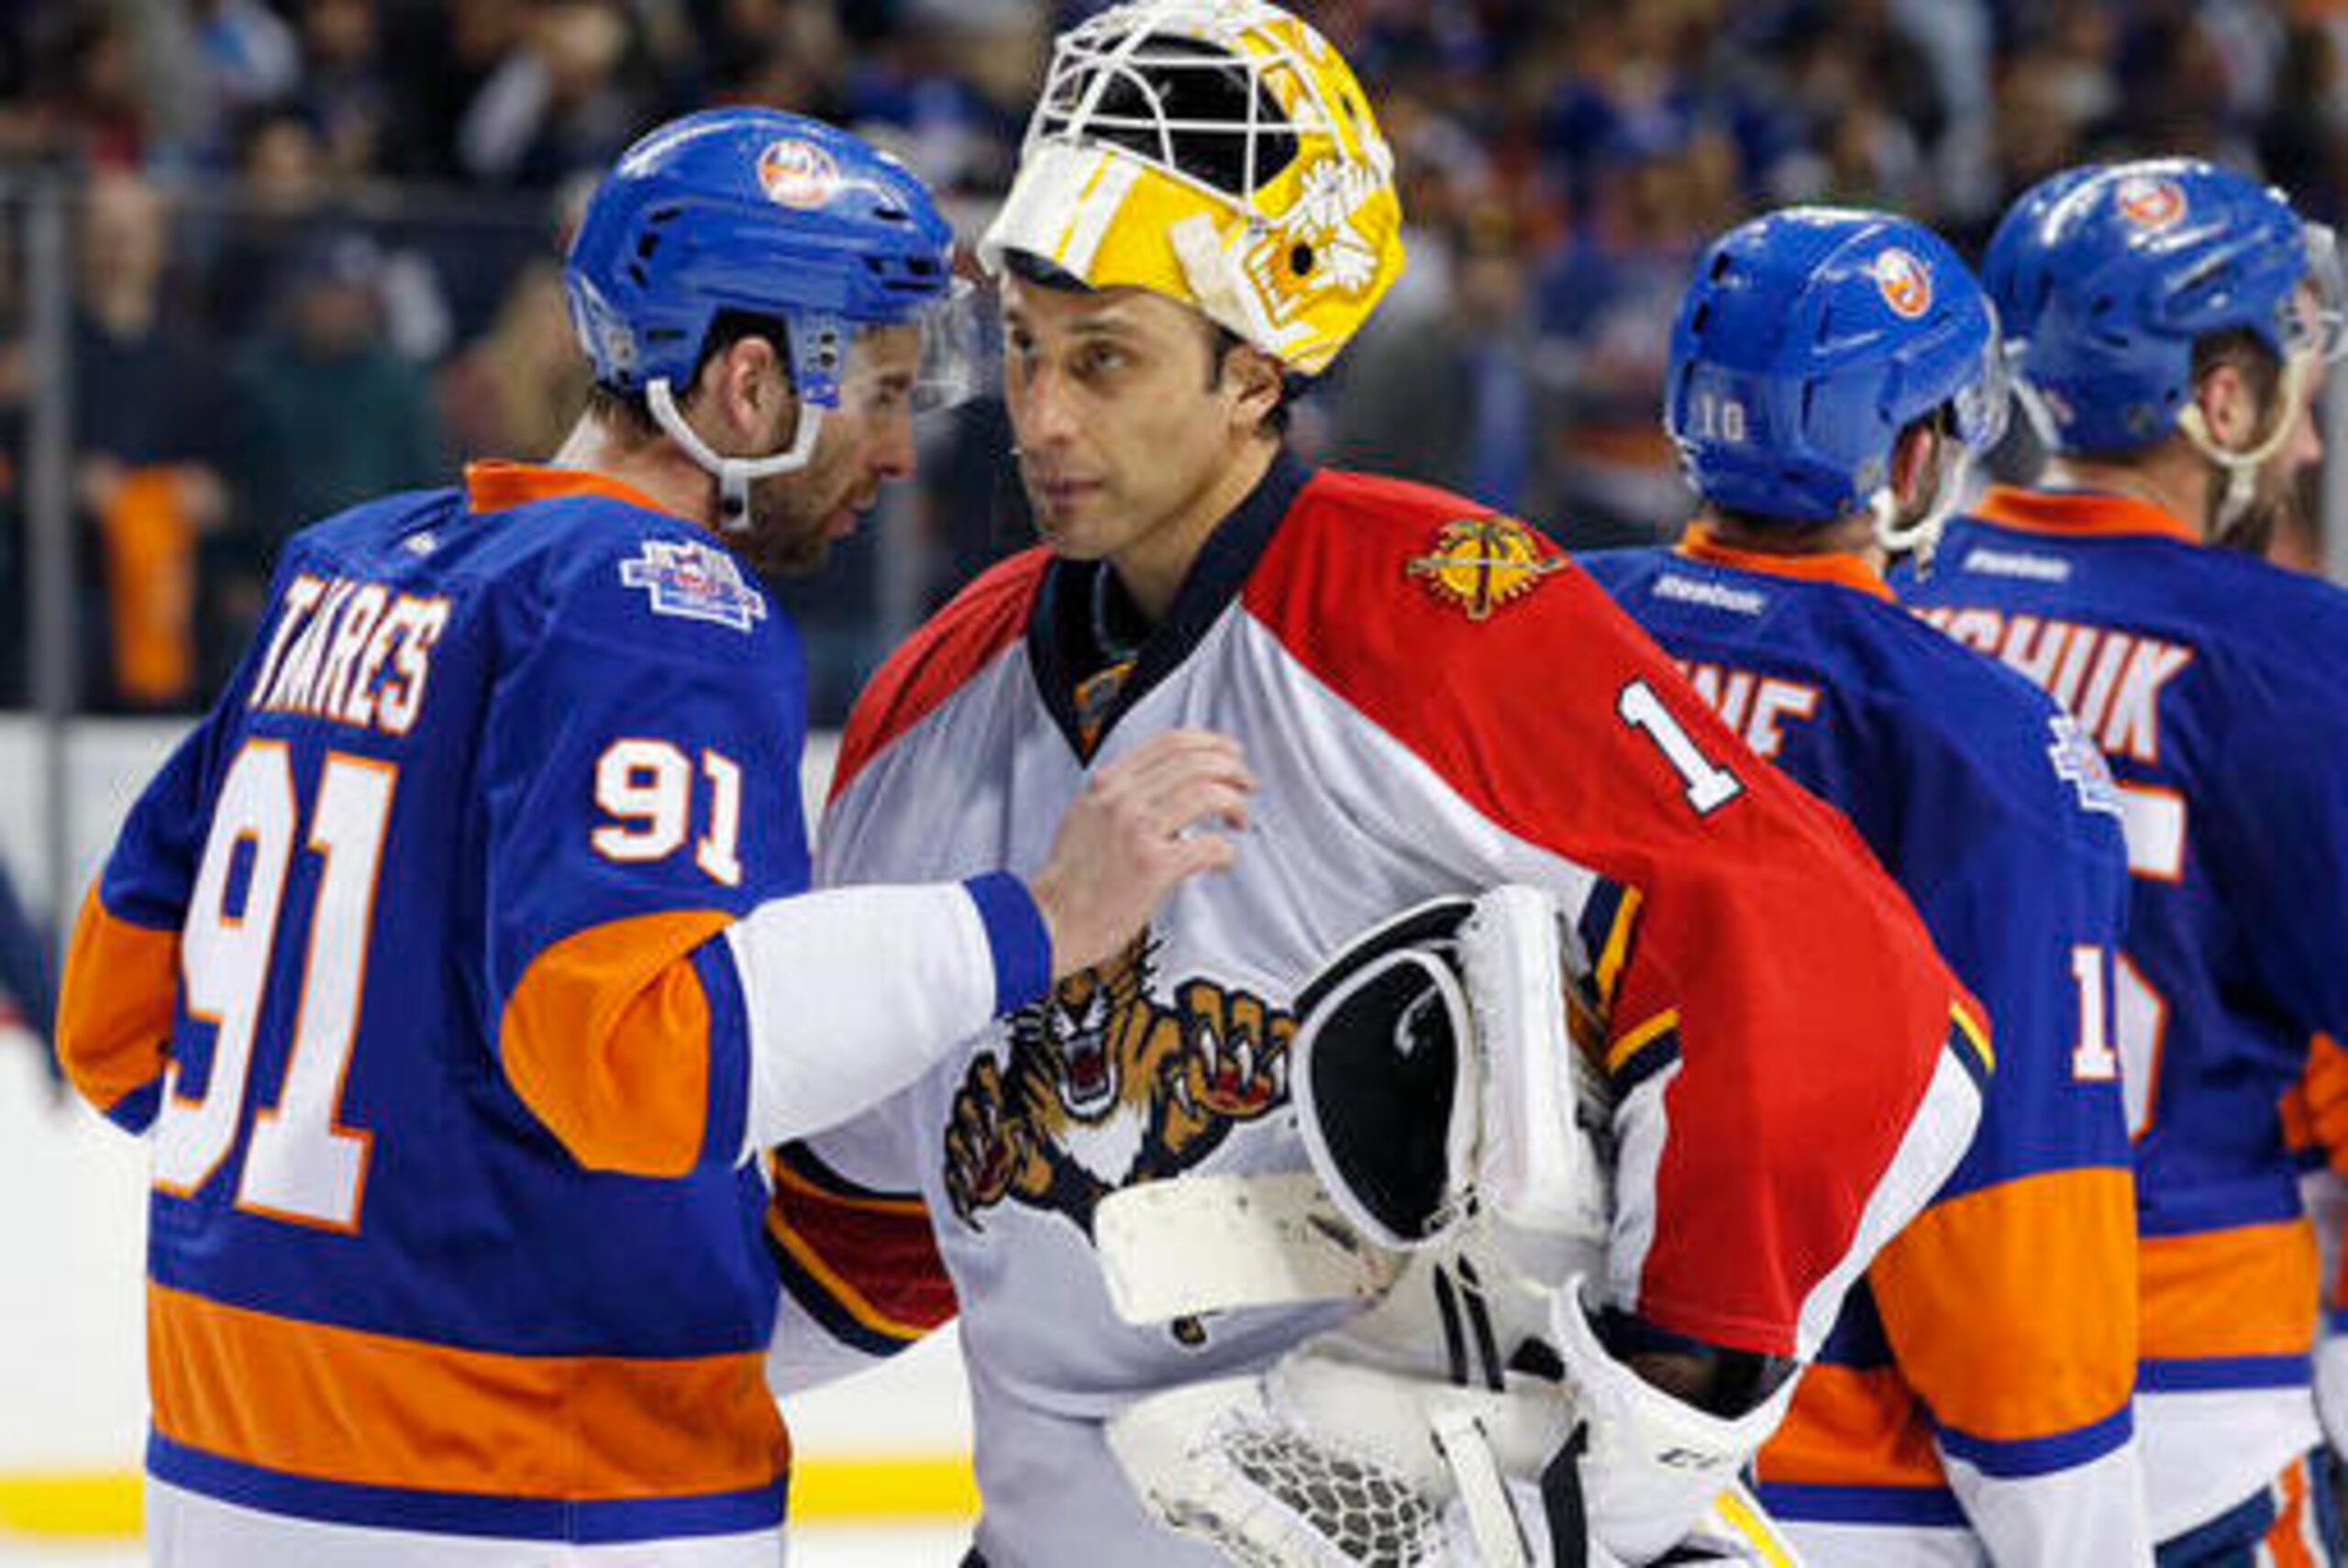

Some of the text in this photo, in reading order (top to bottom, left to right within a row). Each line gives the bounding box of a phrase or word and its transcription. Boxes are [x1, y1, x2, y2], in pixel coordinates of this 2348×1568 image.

[592, 737, 742, 887] 91
[1617, 679, 1744, 817] 1
[150, 738, 399, 1234] 91
